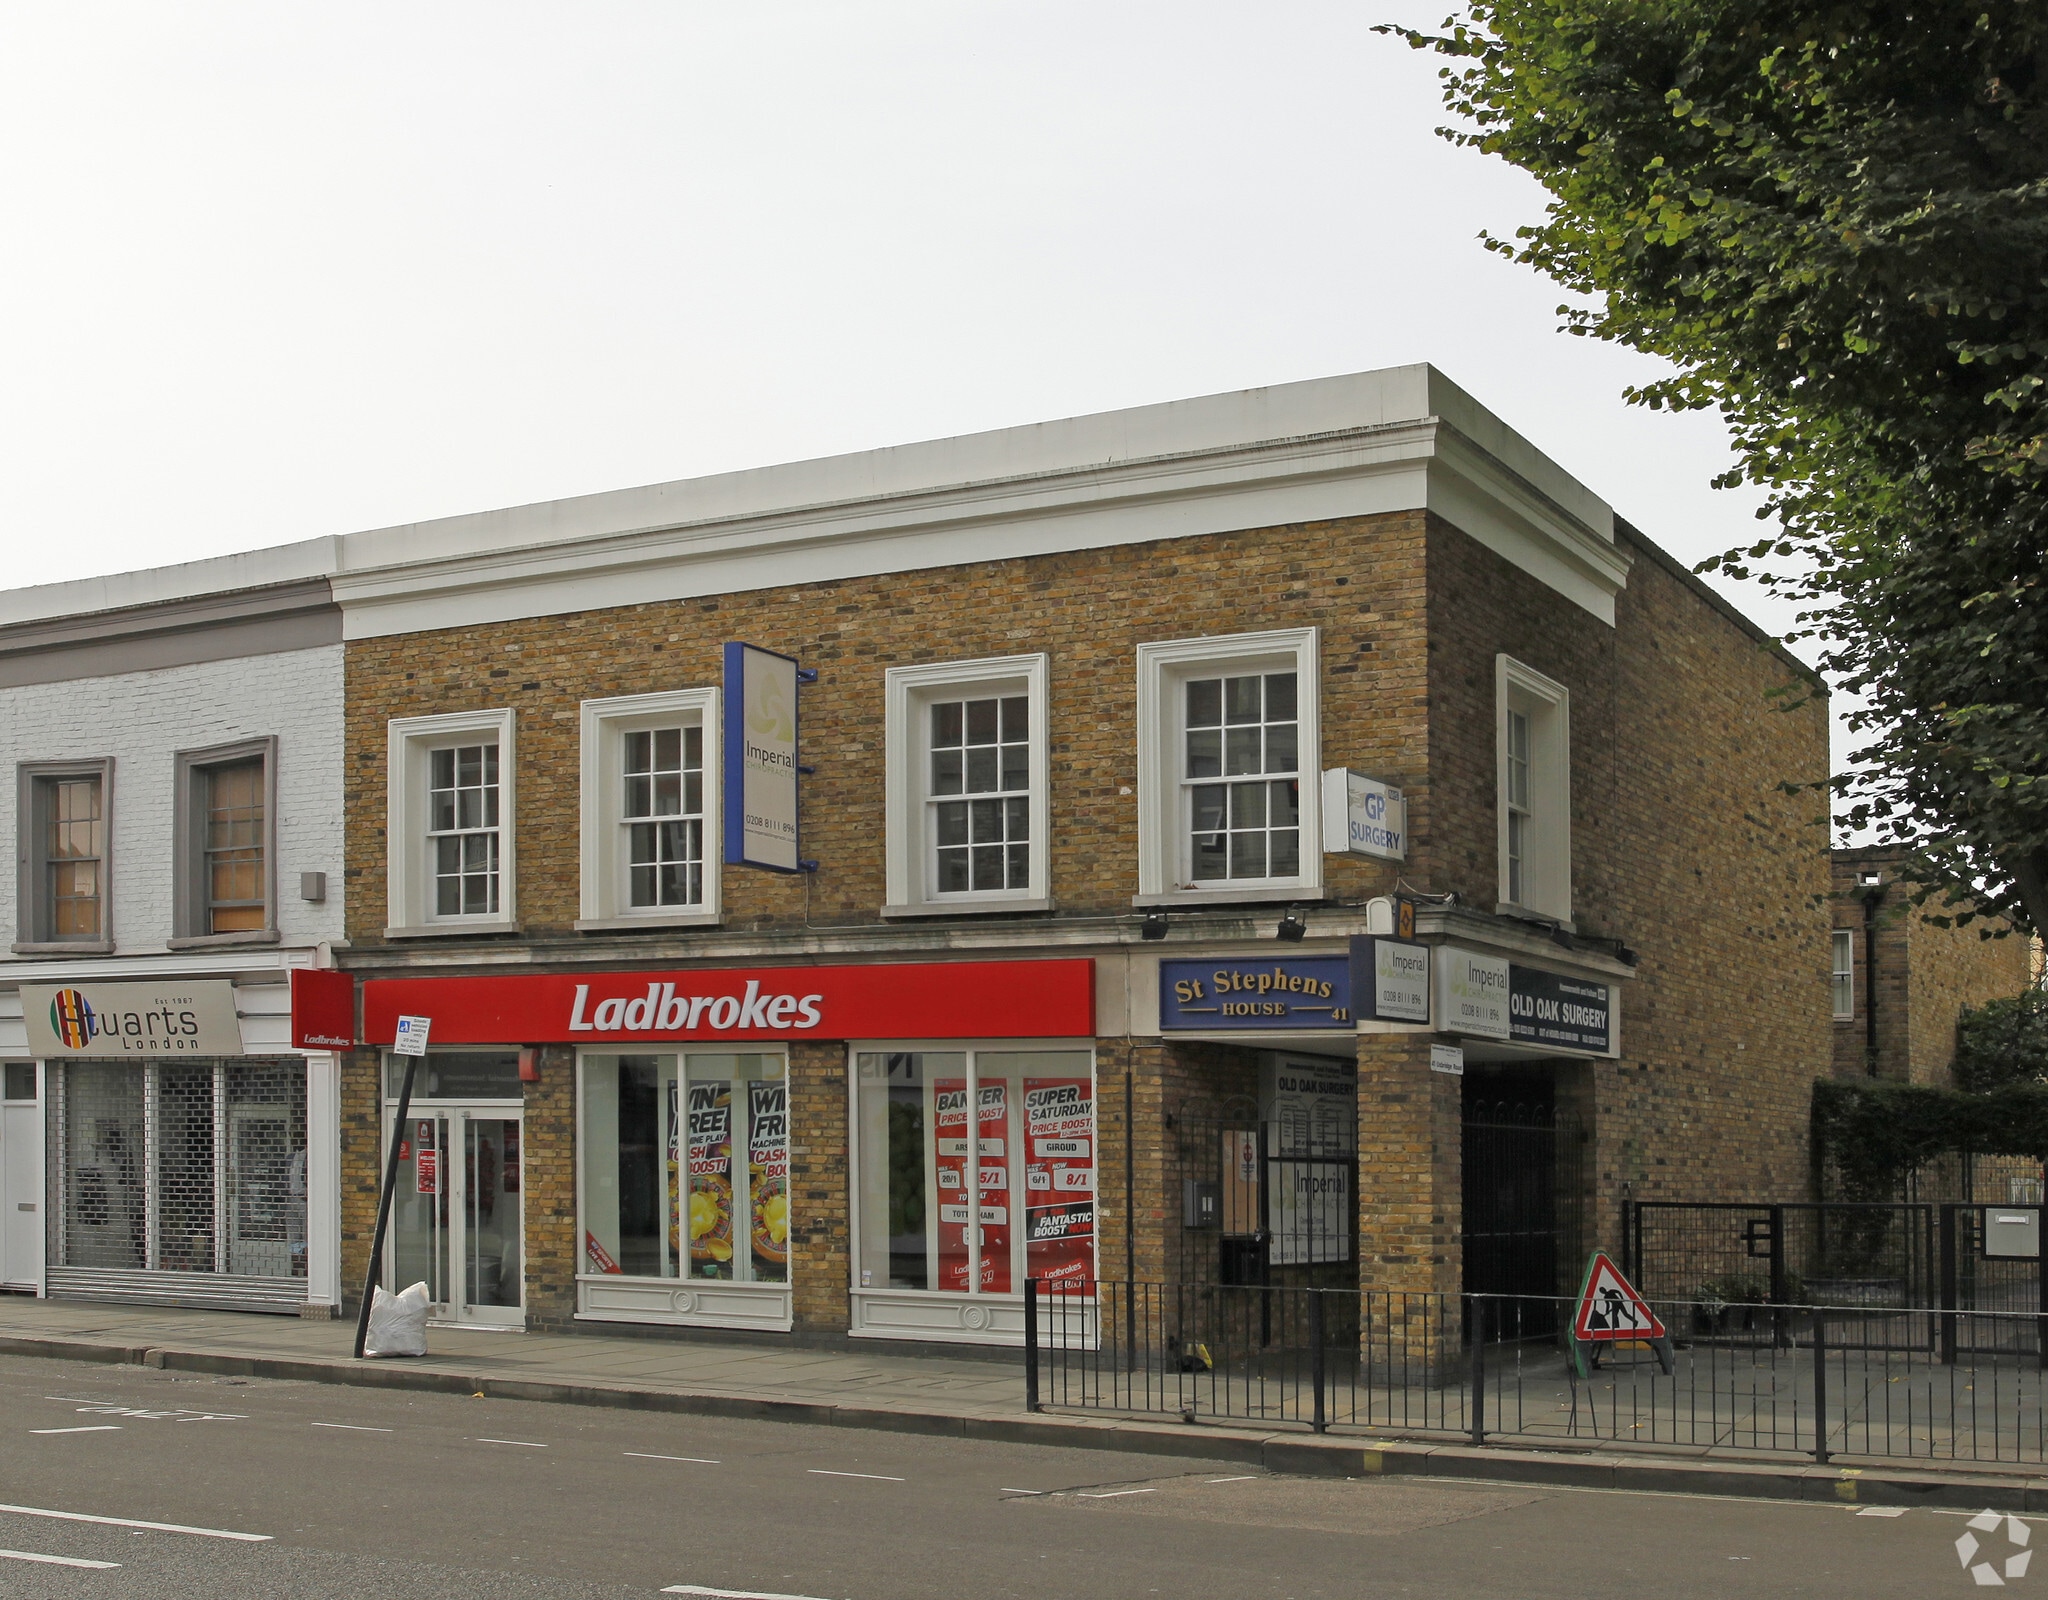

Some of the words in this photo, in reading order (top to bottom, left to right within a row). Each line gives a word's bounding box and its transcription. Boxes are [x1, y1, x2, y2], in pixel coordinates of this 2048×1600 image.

[745, 740, 796, 768] Imperial
[745, 760, 796, 780] CHIROPRACTIC
[1364, 792, 1386, 821] GP
[745, 814, 763, 827] 0208
[764, 818, 780, 830] 8111
[782, 822, 796, 834] 896
[1351, 820, 1401, 850] SURGERY
[1392, 950, 1425, 974] Imperial
[1174, 978, 1205, 1004] St
[1212, 967, 1333, 999] Stephens
[1468, 960, 1508, 992] Imperial
[569, 980, 823, 1031] Ladbrokes
[1383, 990, 1397, 1002] 0208
[1397, 992, 1410, 1004] 8111
[1411, 993, 1422, 1005] 896
[62, 1004, 199, 1037] Stuarts
[1222, 1002, 1286, 1017] HOUSE
[1331, 1007, 1348, 1021] 41
[1461, 1003, 1475, 1017] 0208
[1476, 1006, 1488, 1019] 8111
[1489, 1008, 1500, 1021] 896
[1511, 993, 1534, 1017] OLD
[1536, 998, 1560, 1022] OAK
[1562, 1003, 1607, 1030] SURGERY
[122, 1037, 199, 1050] London
[303, 1033, 350, 1047] Ladbrokes
[1279, 1076, 1297, 1092] OLD
[1299, 1078, 1318, 1094] OAK
[1318, 1081, 1355, 1097] SURGERY
[1027, 1087, 1078, 1108] SUPER
[941, 1113, 968, 1125] PRICE
[978, 1107, 1004, 1120] OOST
[1031, 1102, 1092, 1121] SATURDAY
[673, 1109, 726, 1136] REE
[1031, 1122, 1060, 1134] PRICE
[1060, 1118, 1092, 1130] BOOST
[673, 1146, 706, 1161] CSH
[955, 1143, 987, 1152] ARSAL
[1046, 1143, 1078, 1152] GIROUD
[1052, 1162, 1067, 1170] NOW
[1032, 1175, 1046, 1184] 6/1
[1065, 1174, 1087, 1186] 8/1
[1296, 1170, 1346, 1201] Imperial
[952, 1210, 995, 1220] TOTTHAM
[1040, 1212, 1093, 1228] FANTASTIC
[1034, 1224, 1067, 1238] BOOST
[1068, 1222, 1093, 1234] NOW
[1044, 1261, 1083, 1280] Ladbrokes
